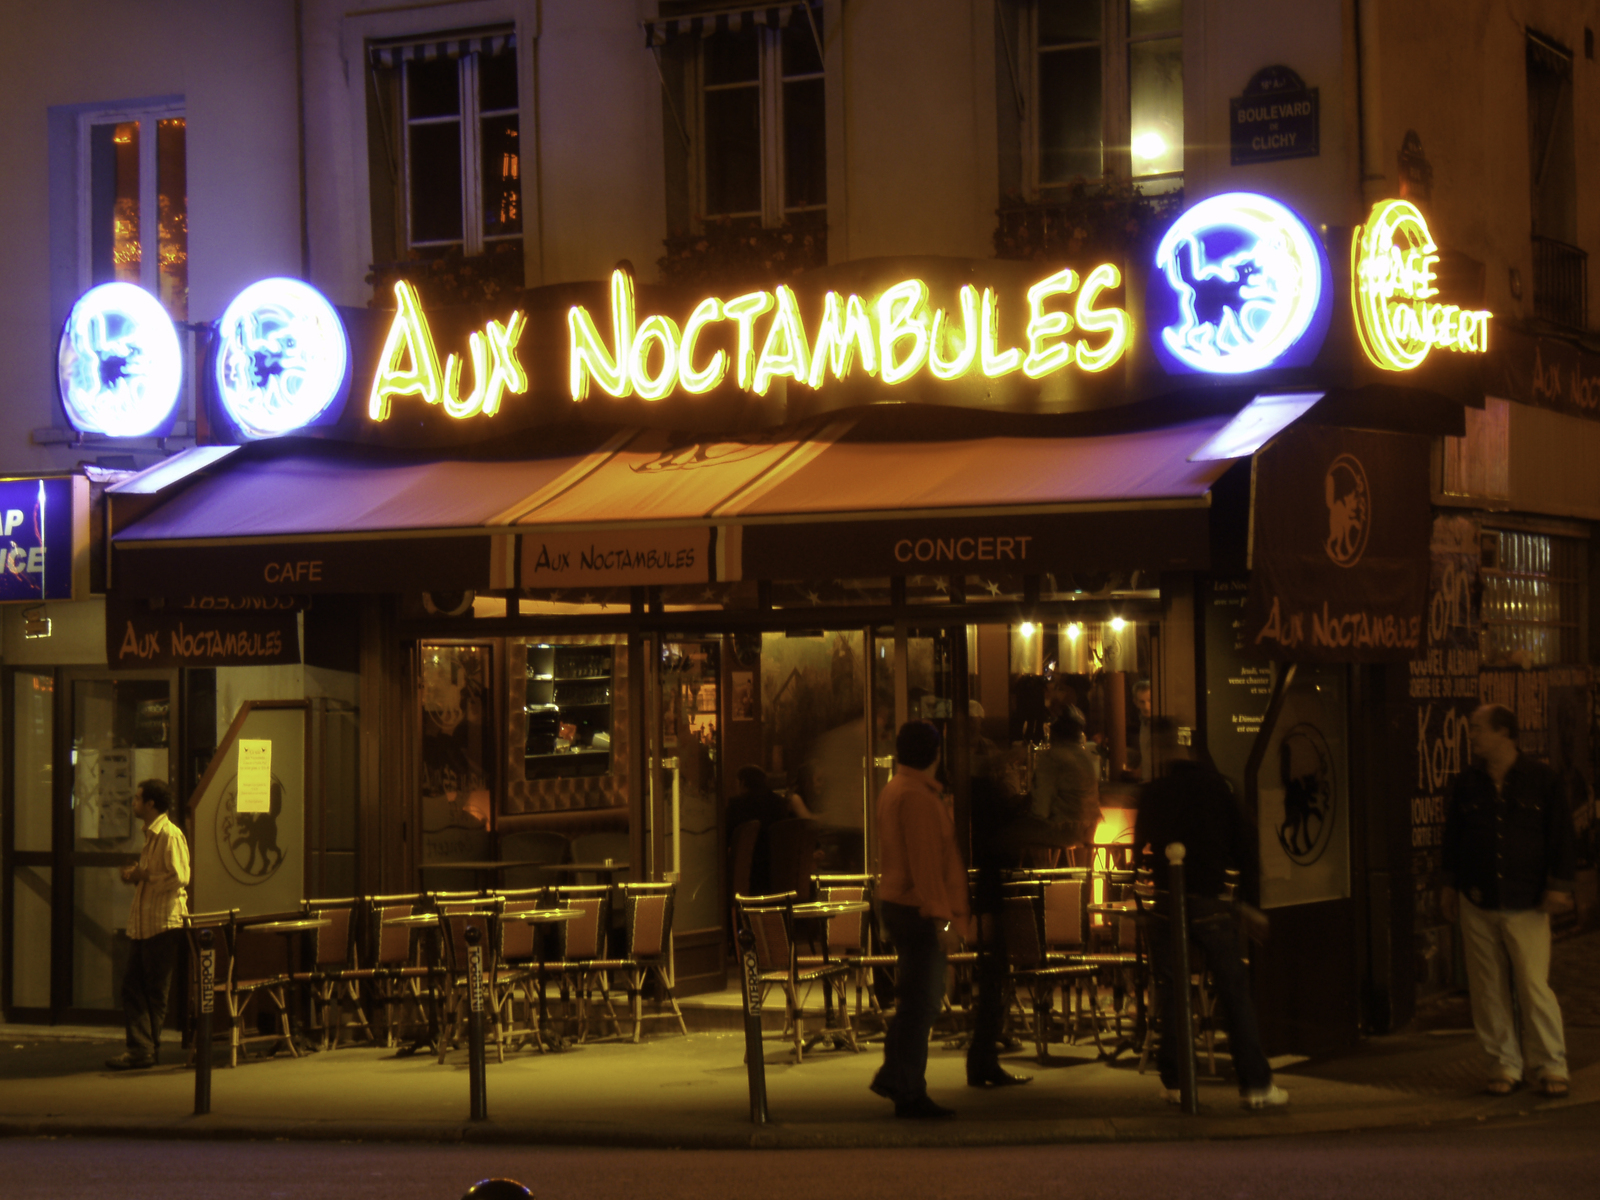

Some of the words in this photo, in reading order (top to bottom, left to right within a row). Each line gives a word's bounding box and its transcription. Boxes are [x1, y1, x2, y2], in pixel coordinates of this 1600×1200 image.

[1237, 101, 1312, 124] BOULEVARD
[1252, 132, 1298, 151] CLICHY
[369, 280, 529, 421] AUX
[569, 264, 1136, 401] NOCTAMBULES
[534, 544, 571, 573] AUX
[580, 544, 695, 571] NOCTAMBULES
[895, 536, 1032, 563] CONCERT
[263, 560, 323, 584] CAFE
[119, 620, 161, 660] AUX
[171, 621, 283, 658] NOCTAMBULES
[202, 950, 214, 1013] INTERPOL
[469, 947, 483, 1012] INTERPOL
